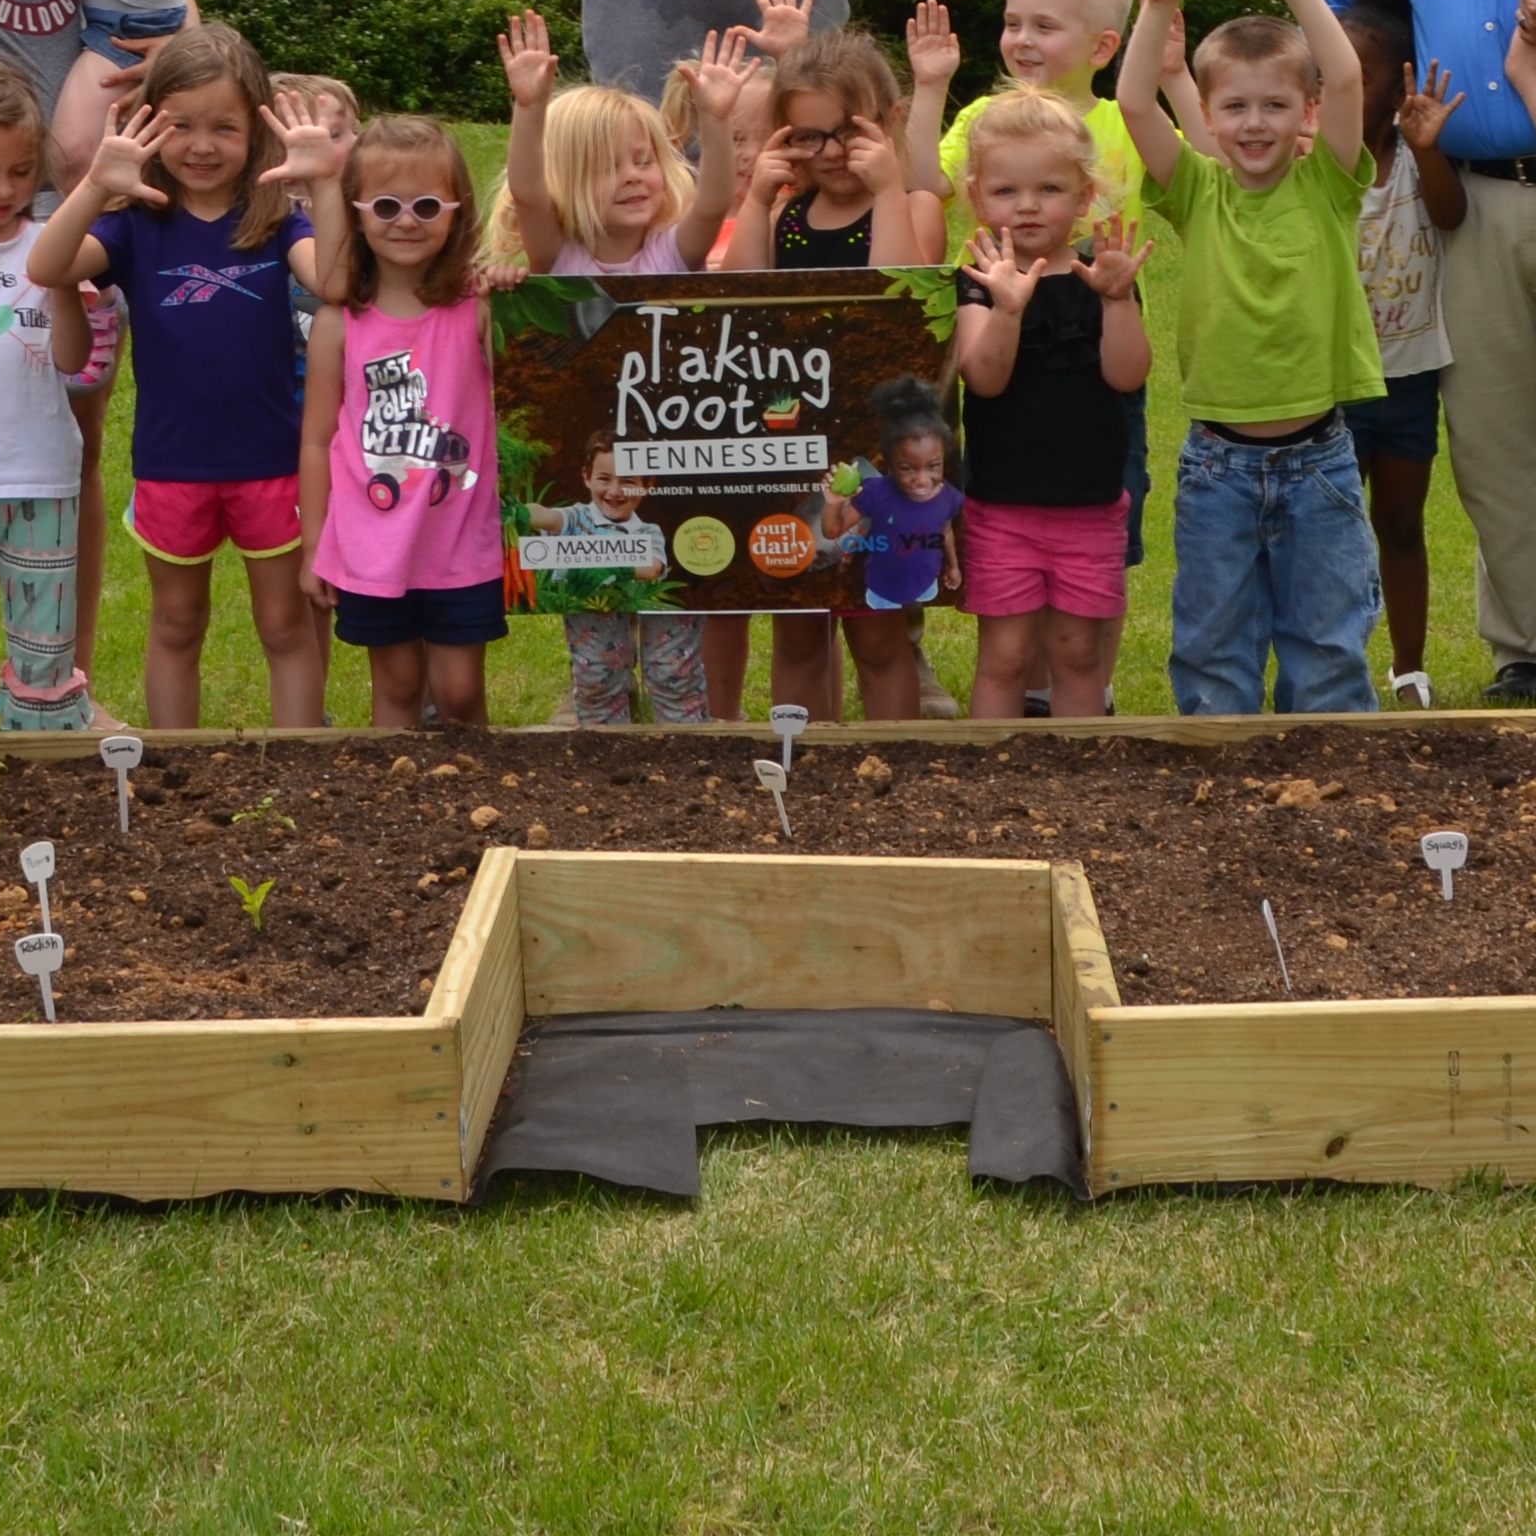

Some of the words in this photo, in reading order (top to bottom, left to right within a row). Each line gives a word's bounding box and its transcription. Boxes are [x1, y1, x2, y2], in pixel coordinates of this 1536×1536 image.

[636, 306, 831, 408] Taking
[365, 354, 411, 390] JUST
[616, 351, 758, 436] Root
[364, 383, 412, 431] ROLL
[363, 422, 440, 459] WITH
[622, 441, 820, 470] TENNESSEE
[623, 487, 646, 497] THIS
[648, 485, 693, 495] GARDEN
[698, 484, 722, 494] WAS
[723, 484, 755, 494] MADE
[757, 482, 809, 493] POSSIBLE
[756, 524, 790, 535] our
[556, 539, 648, 556] MAXIMUS
[752, 524, 812, 558] daily
[841, 535, 889, 553] CNS
[556, 554, 647, 563] FOUNDATION
[766, 555, 798, 565] bread
[1425, 839, 1465, 854] Squash
[19, 937, 59, 954] Radish
